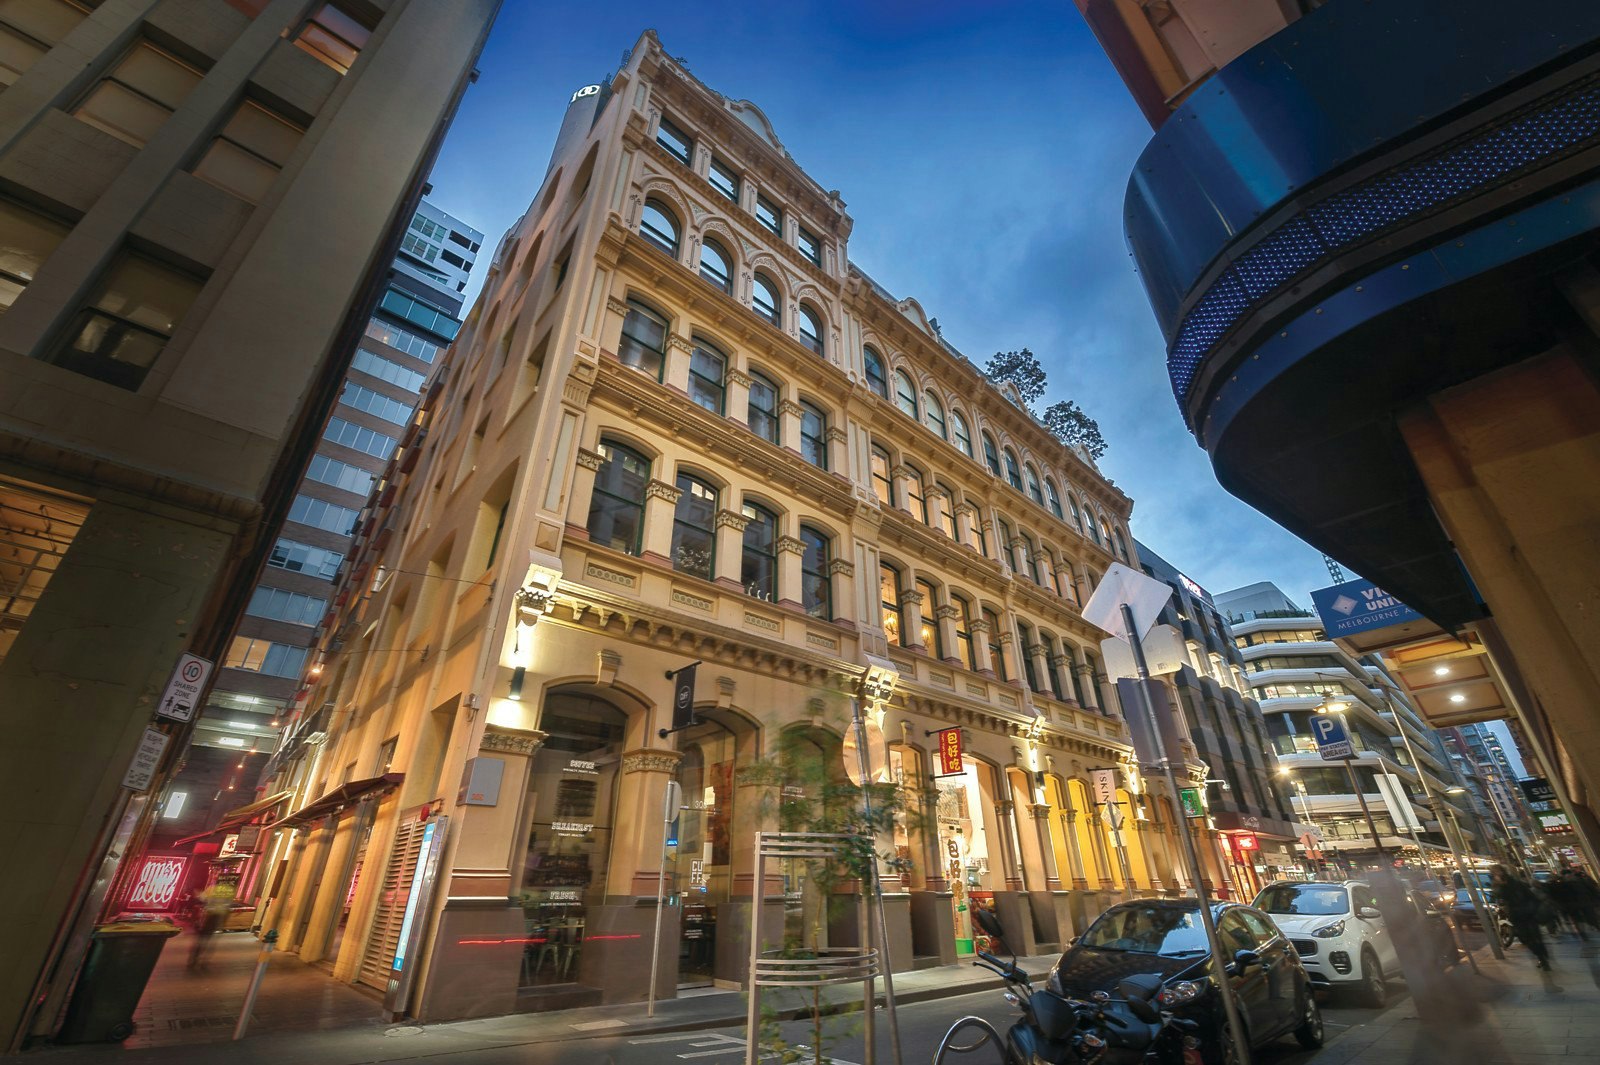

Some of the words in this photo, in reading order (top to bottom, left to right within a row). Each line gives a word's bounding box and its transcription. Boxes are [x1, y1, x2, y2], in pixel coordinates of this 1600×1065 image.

[1360, 586, 1390, 600] VI
[1337, 610, 1400, 630] MELBOURNE
[186, 665, 199, 678] 10
[174, 680, 198, 693] SHARED
[174, 688, 191, 699] ZONE
[1317, 719, 1334, 740] P
[947, 732, 961, 771] 包好吃
[1323, 748, 1339, 758] AREA
[1099, 776, 1110, 802] SKIN
[551, 821, 594, 832] BREAKFAST
